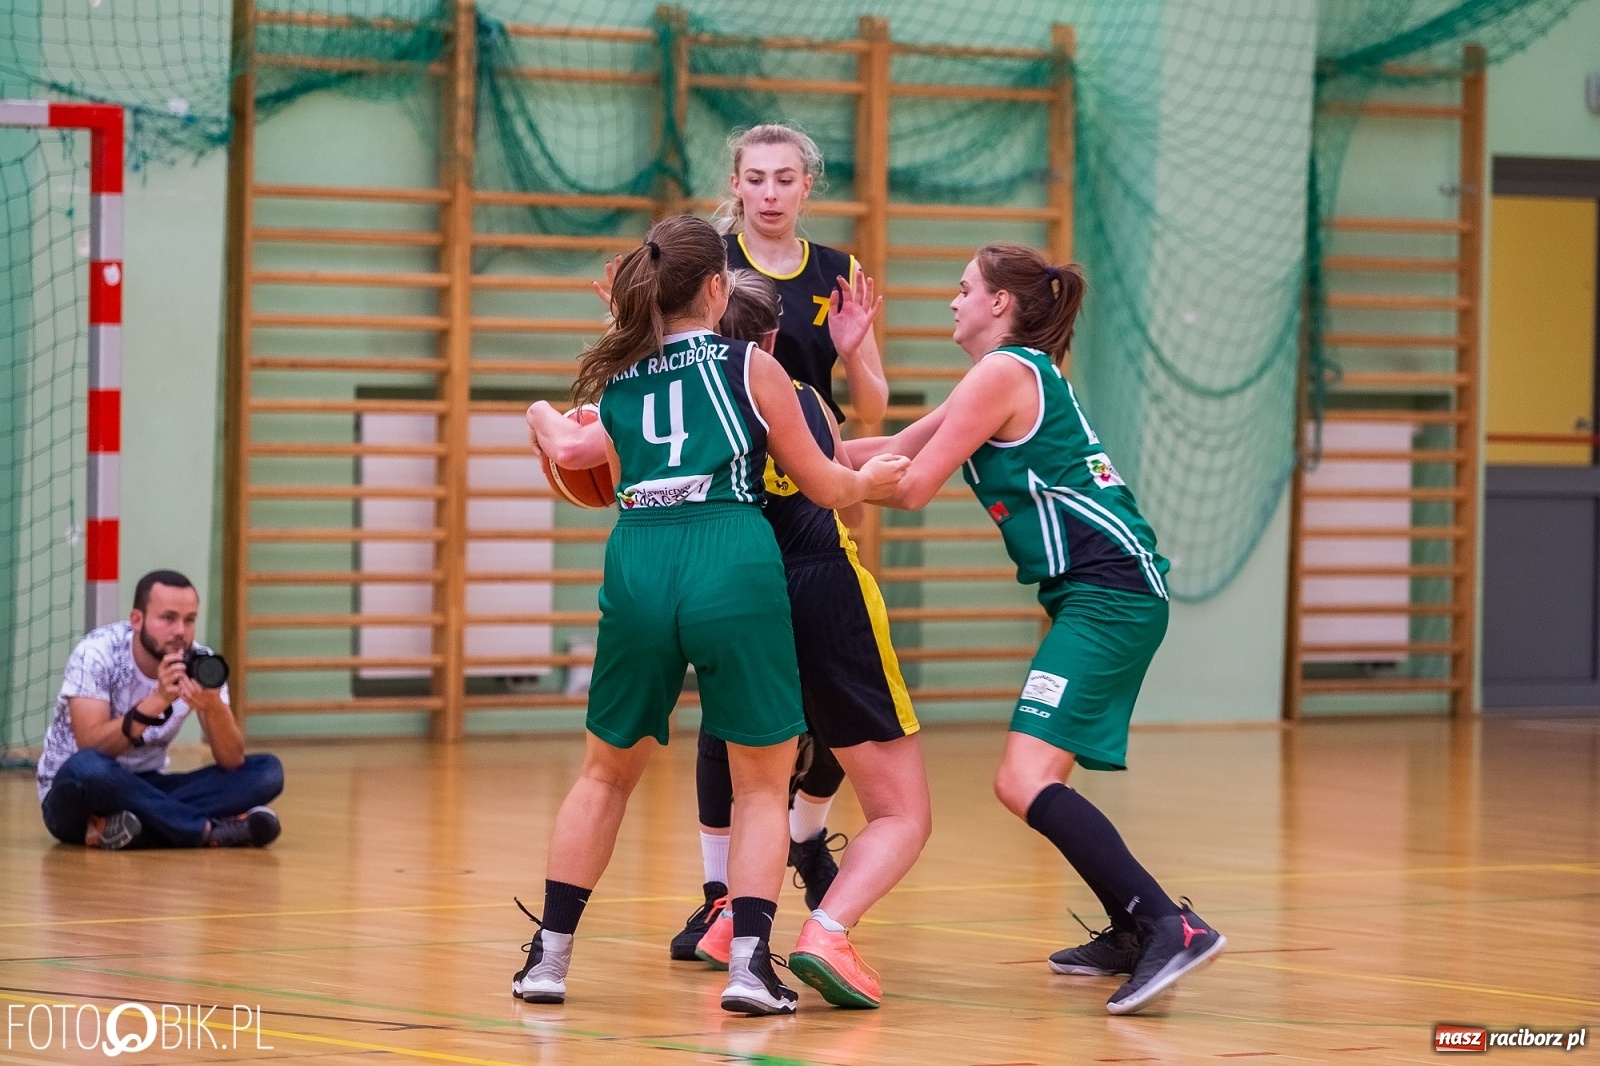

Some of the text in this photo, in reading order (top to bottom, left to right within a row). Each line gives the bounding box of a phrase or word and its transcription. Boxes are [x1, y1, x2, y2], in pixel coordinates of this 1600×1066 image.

[812, 294, 830, 326] 7
[648, 342, 729, 374] RACIBÓRZ
[642, 379, 689, 467] 4
